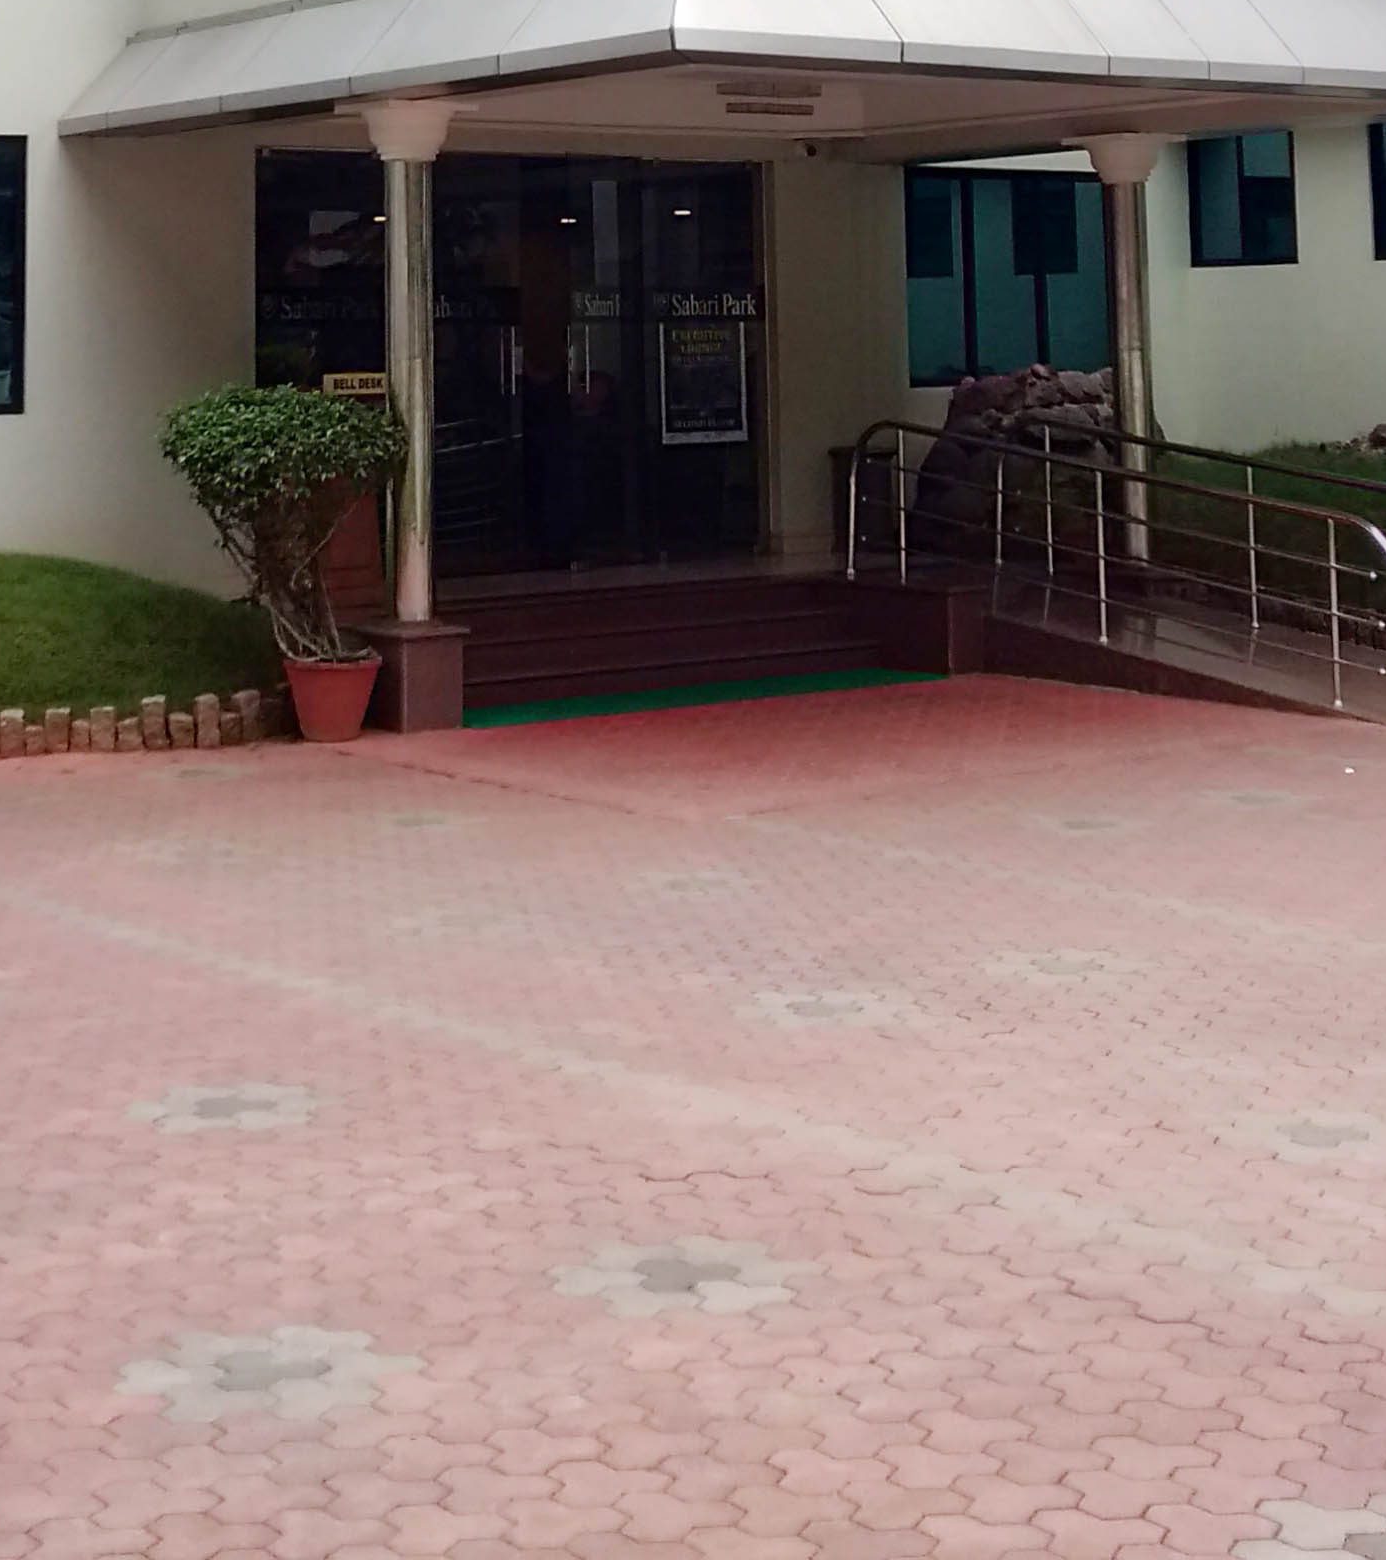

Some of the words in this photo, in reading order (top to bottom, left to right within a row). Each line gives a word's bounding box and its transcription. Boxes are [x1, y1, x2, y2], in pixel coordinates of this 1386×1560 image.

[671, 293, 719, 316] Sabari
[722, 293, 757, 316] Park
[333, 378, 357, 390] BELL
[358, 377, 384, 389] DESK
